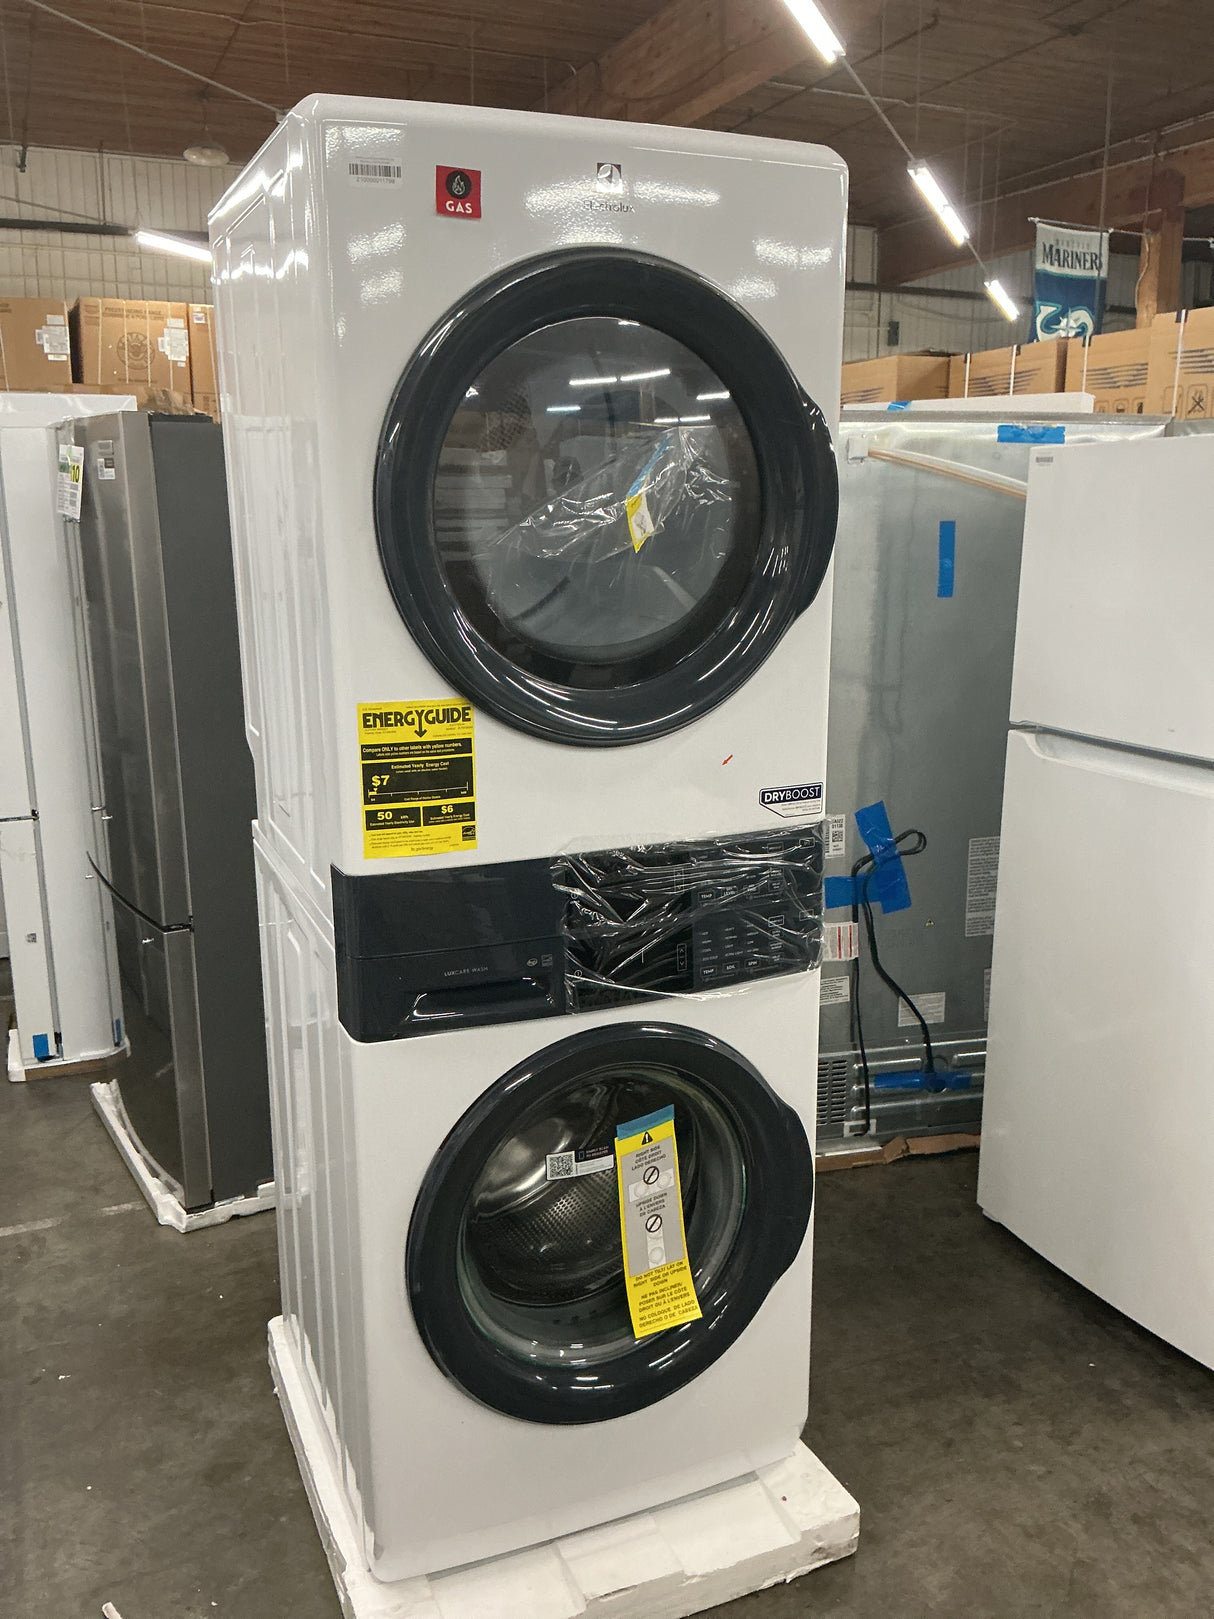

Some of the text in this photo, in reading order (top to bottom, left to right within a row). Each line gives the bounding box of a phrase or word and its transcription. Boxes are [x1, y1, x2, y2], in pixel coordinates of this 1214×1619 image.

[445, 200, 473, 214] GAS
[362, 706, 471, 731] ENERGYGUIDE
[371, 775, 390, 787] $7
[764, 786, 820, 803] DRYBOOST
[377, 811, 393, 821] 50
[441, 805, 454, 814] $6
[631, 1154, 667, 1171] LADO DERECHO
[647, 1205, 666, 1215] CABEZA
[681, 1299, 695, 1308] LADO
[639, 1317, 663, 1328] DERECHO
[678, 1305, 698, 1315] CABEZA
